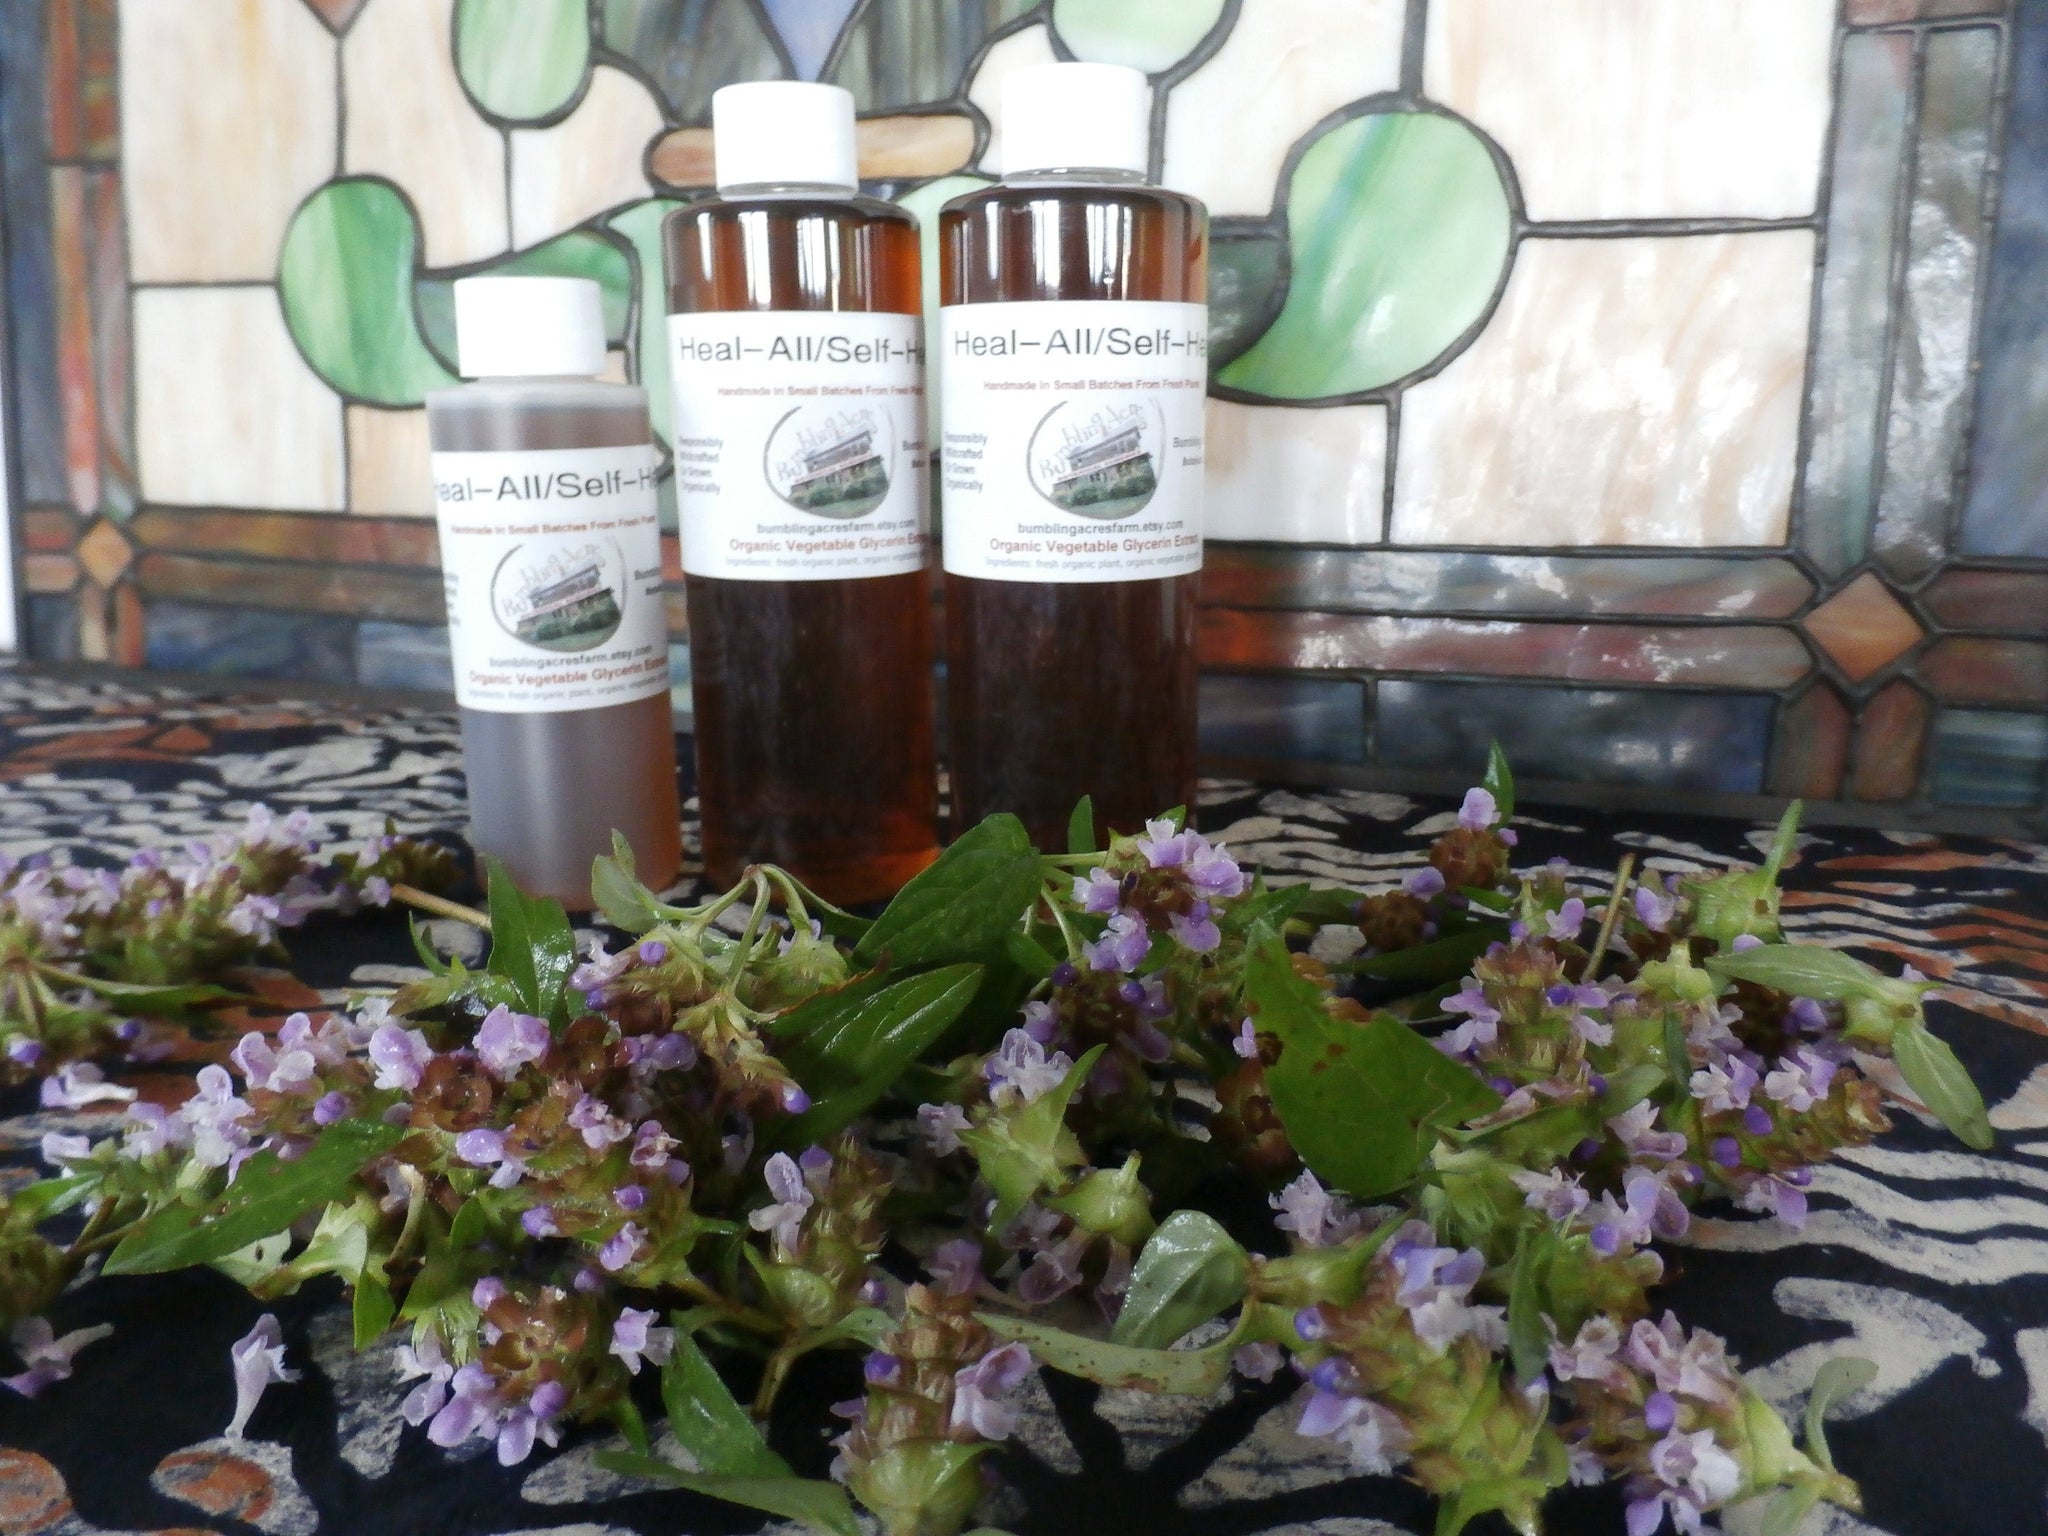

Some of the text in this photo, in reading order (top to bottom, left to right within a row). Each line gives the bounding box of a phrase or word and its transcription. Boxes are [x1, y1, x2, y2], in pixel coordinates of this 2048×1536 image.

[718, 387, 771, 396] Handmade
[787, 386, 818, 396] Small
[821, 386, 863, 396] Batches
[866, 386, 888, 396] From
[984, 381, 1036, 391] Handmade
[1053, 380, 1085, 390] Small
[1089, 379, 1133, 390] Batches
[1136, 379, 1161, 389] From
[434, 468, 656, 502] eal-All/Self-H
[508, 524, 539, 534] Small
[542, 522, 587, 534] Batches
[590, 520, 616, 530] From
[757, 519, 915, 535] bumblingacresfarm.etsy.com
[1017, 519, 1184, 537] bumblingacresfarm.etsy.com
[729, 539, 781, 554] Organic
[785, 539, 855, 554] Vegetable
[859, 537, 905, 552] Glycerin
[990, 538, 1041, 554] Organic
[1046, 539, 1118, 556] Vegetable
[1122, 537, 1171, 555] Glycerin
[776, 557, 799, 568] fresh
[801, 558, 834, 570] organic
[1036, 558, 1060, 569] fresh
[1061, 560, 1095, 571] organic
[1098, 559, 1123, 571] plant,
[1126, 557, 1154, 569] organic
[489, 644, 652, 669] bumblingacresfarm.etsy.com
[468, 670, 512, 686] Organic
[516, 671, 587, 688] Vegetable
[591, 663, 643, 681] Glycerin
